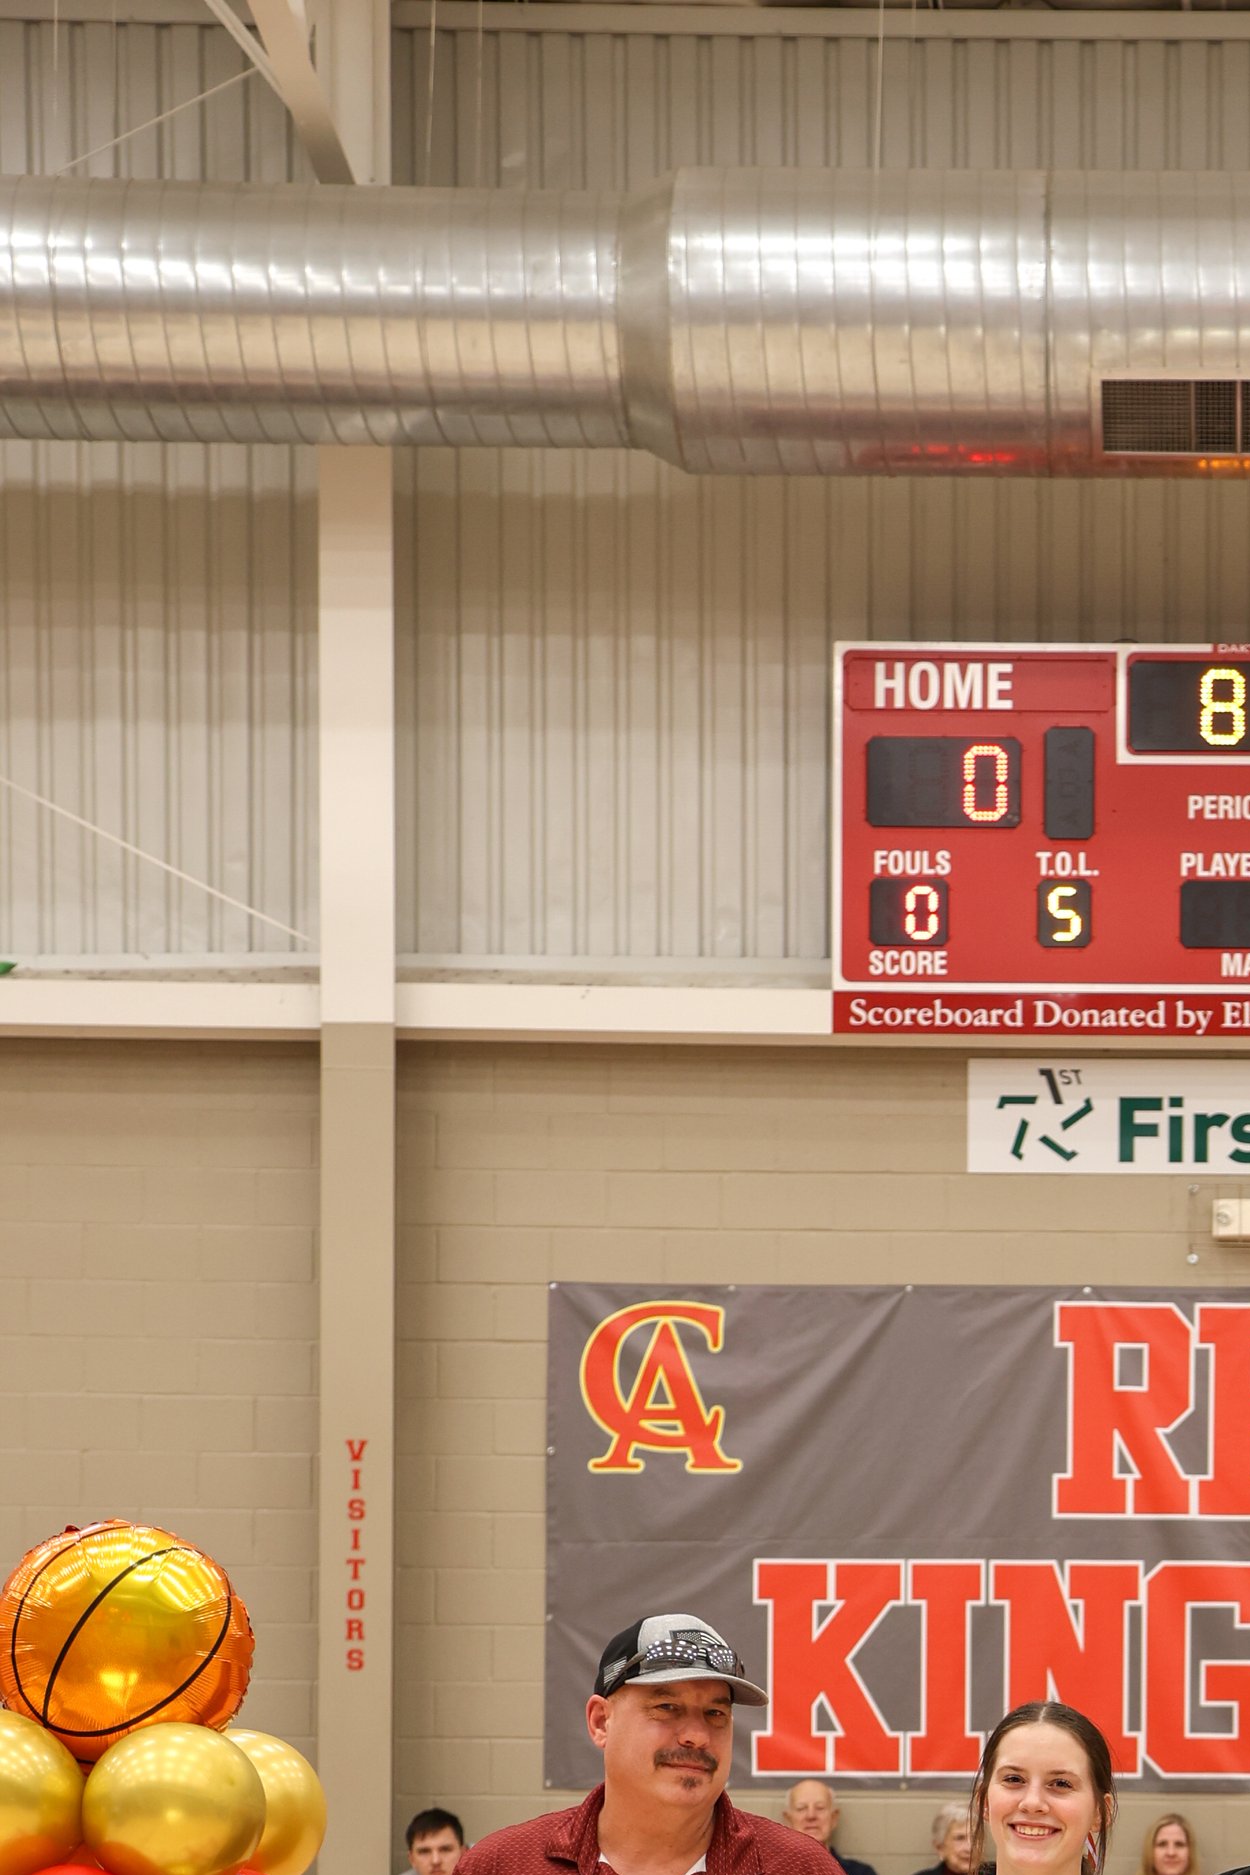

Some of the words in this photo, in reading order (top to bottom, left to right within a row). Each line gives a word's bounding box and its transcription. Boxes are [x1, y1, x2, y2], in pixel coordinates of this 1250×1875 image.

[874, 661, 1014, 710] HOME
[963, 744, 1008, 822] 0
[874, 849, 952, 876] FOULS
[1035, 851, 1100, 877] T.O.L.
[904, 885, 939, 941] 0
[1047, 886, 1082, 942] 5
[869, 950, 948, 976] SCORE
[849, 998, 1024, 1027] Scoreboard
[1034, 1000, 1165, 1028] Donated
[1176, 1000, 1212, 1035] by
[345, 1439, 367, 1672] VISITORS
